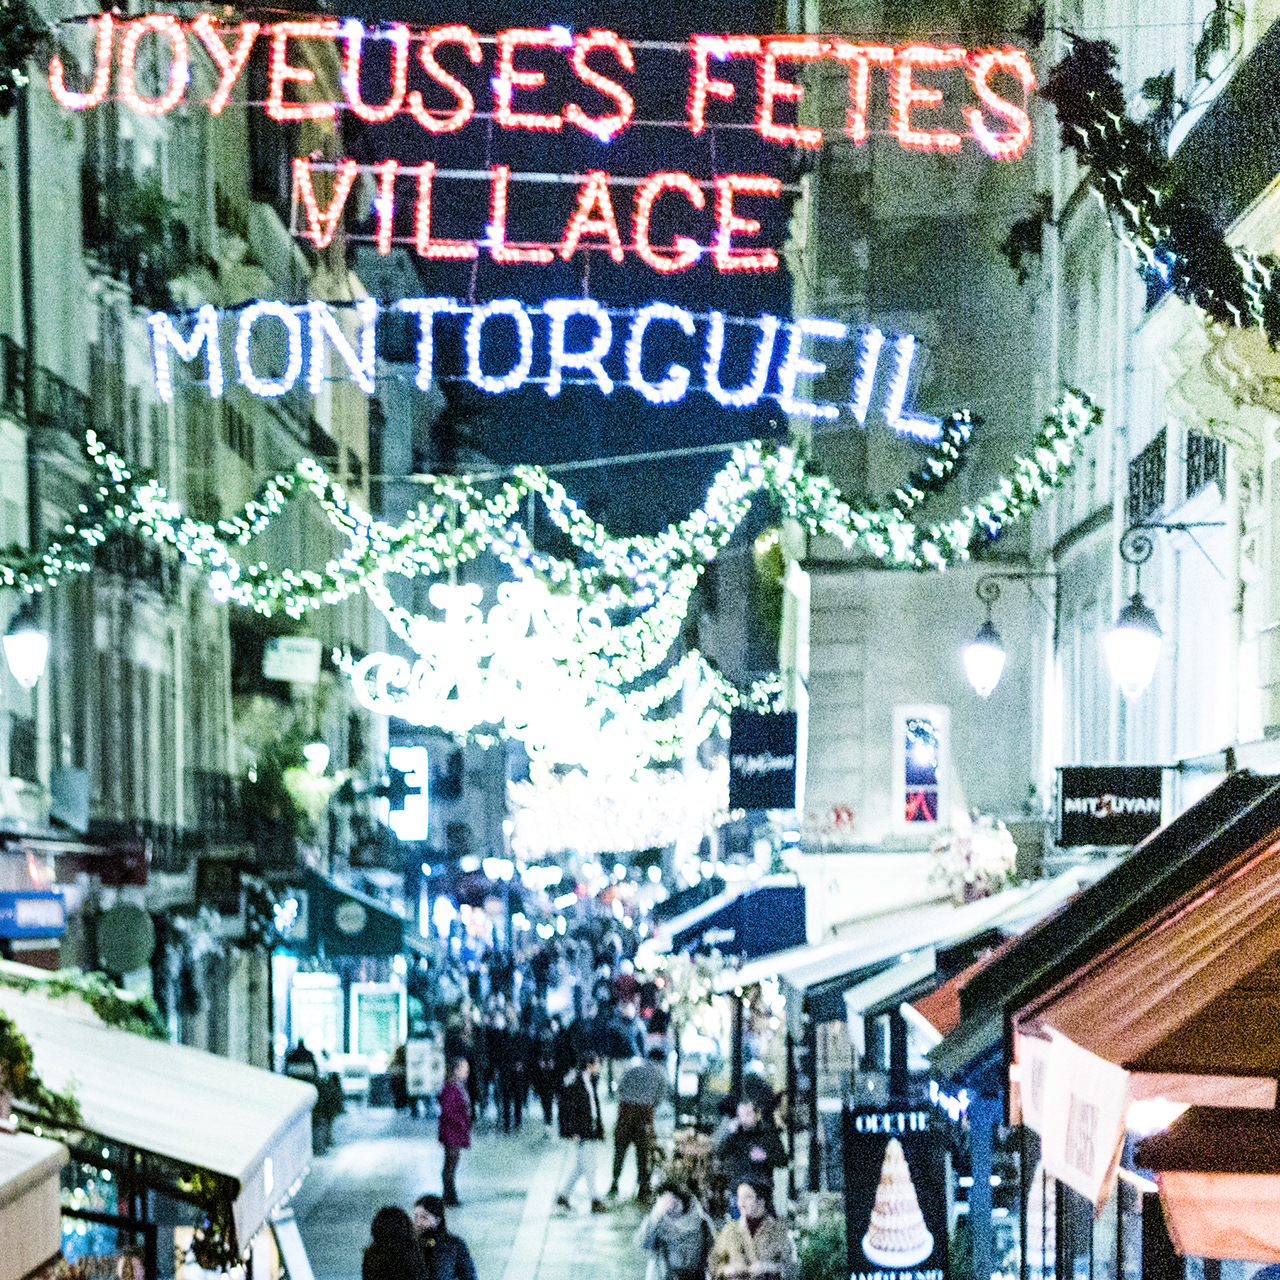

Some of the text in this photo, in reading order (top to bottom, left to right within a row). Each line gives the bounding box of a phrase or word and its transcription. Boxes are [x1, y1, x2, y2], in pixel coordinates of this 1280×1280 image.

[49, 12, 1037, 160] JOYEUSES FETES
[292, 158, 782, 274] VILLAGE
[148, 296, 943, 442] MONTORGUEIL
